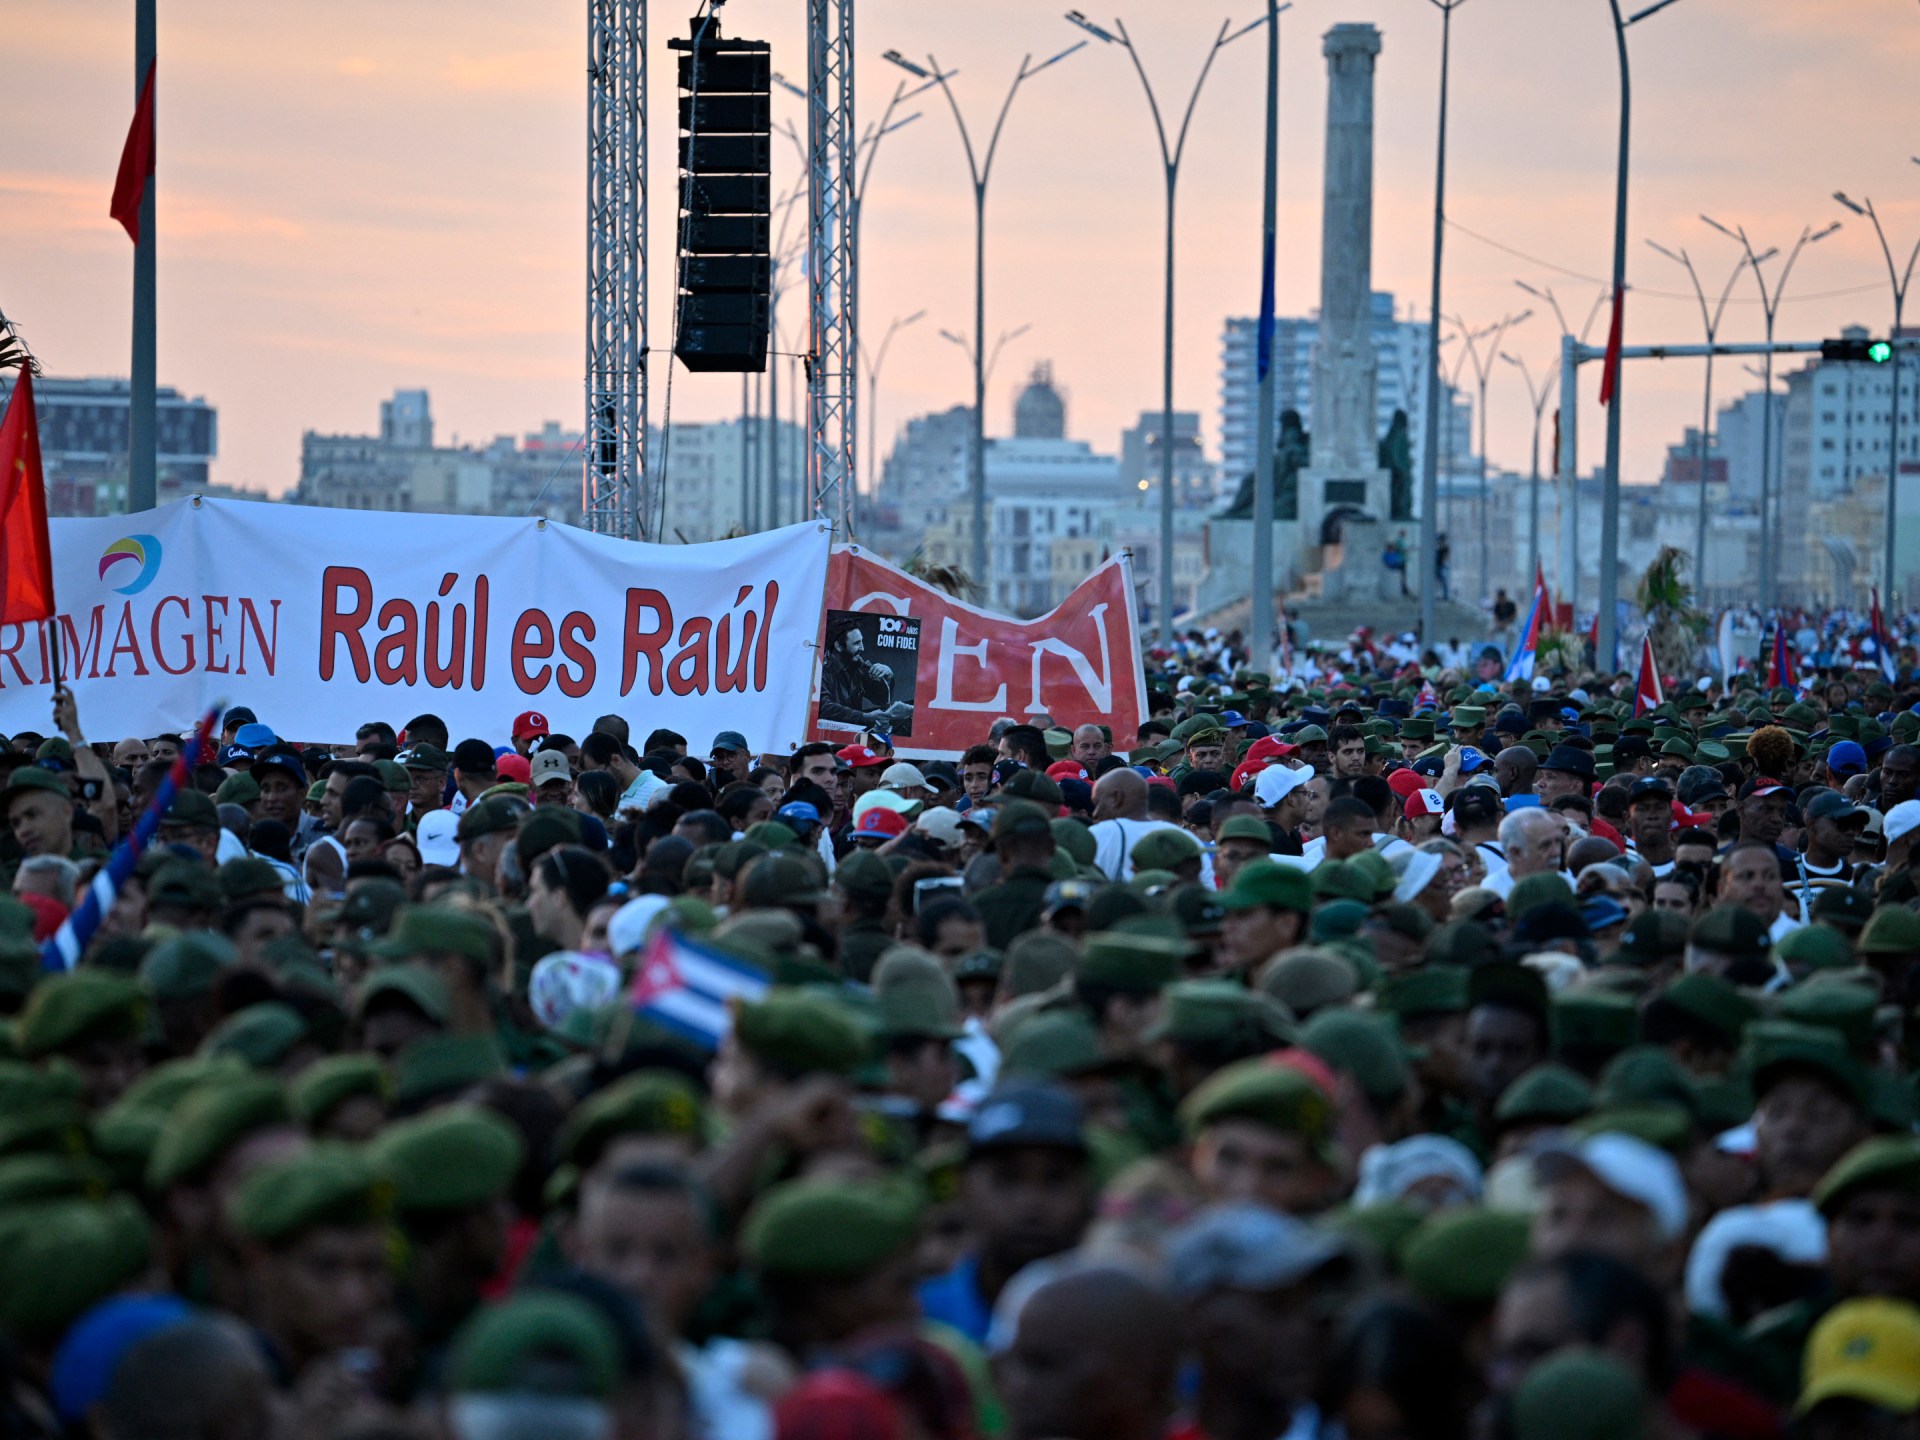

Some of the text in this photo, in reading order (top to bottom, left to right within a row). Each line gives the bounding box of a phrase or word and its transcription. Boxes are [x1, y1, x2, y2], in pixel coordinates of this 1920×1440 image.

[319, 565, 780, 698] Raúl es Raúl
[906, 626, 919, 635] AÑOS
[877, 634, 917, 650] CON FIDEL
[529, 714, 542, 727] C
[228, 747, 249, 758] Cuba
[1429, 794, 1445, 808] CU
[865, 812, 881, 829] C
